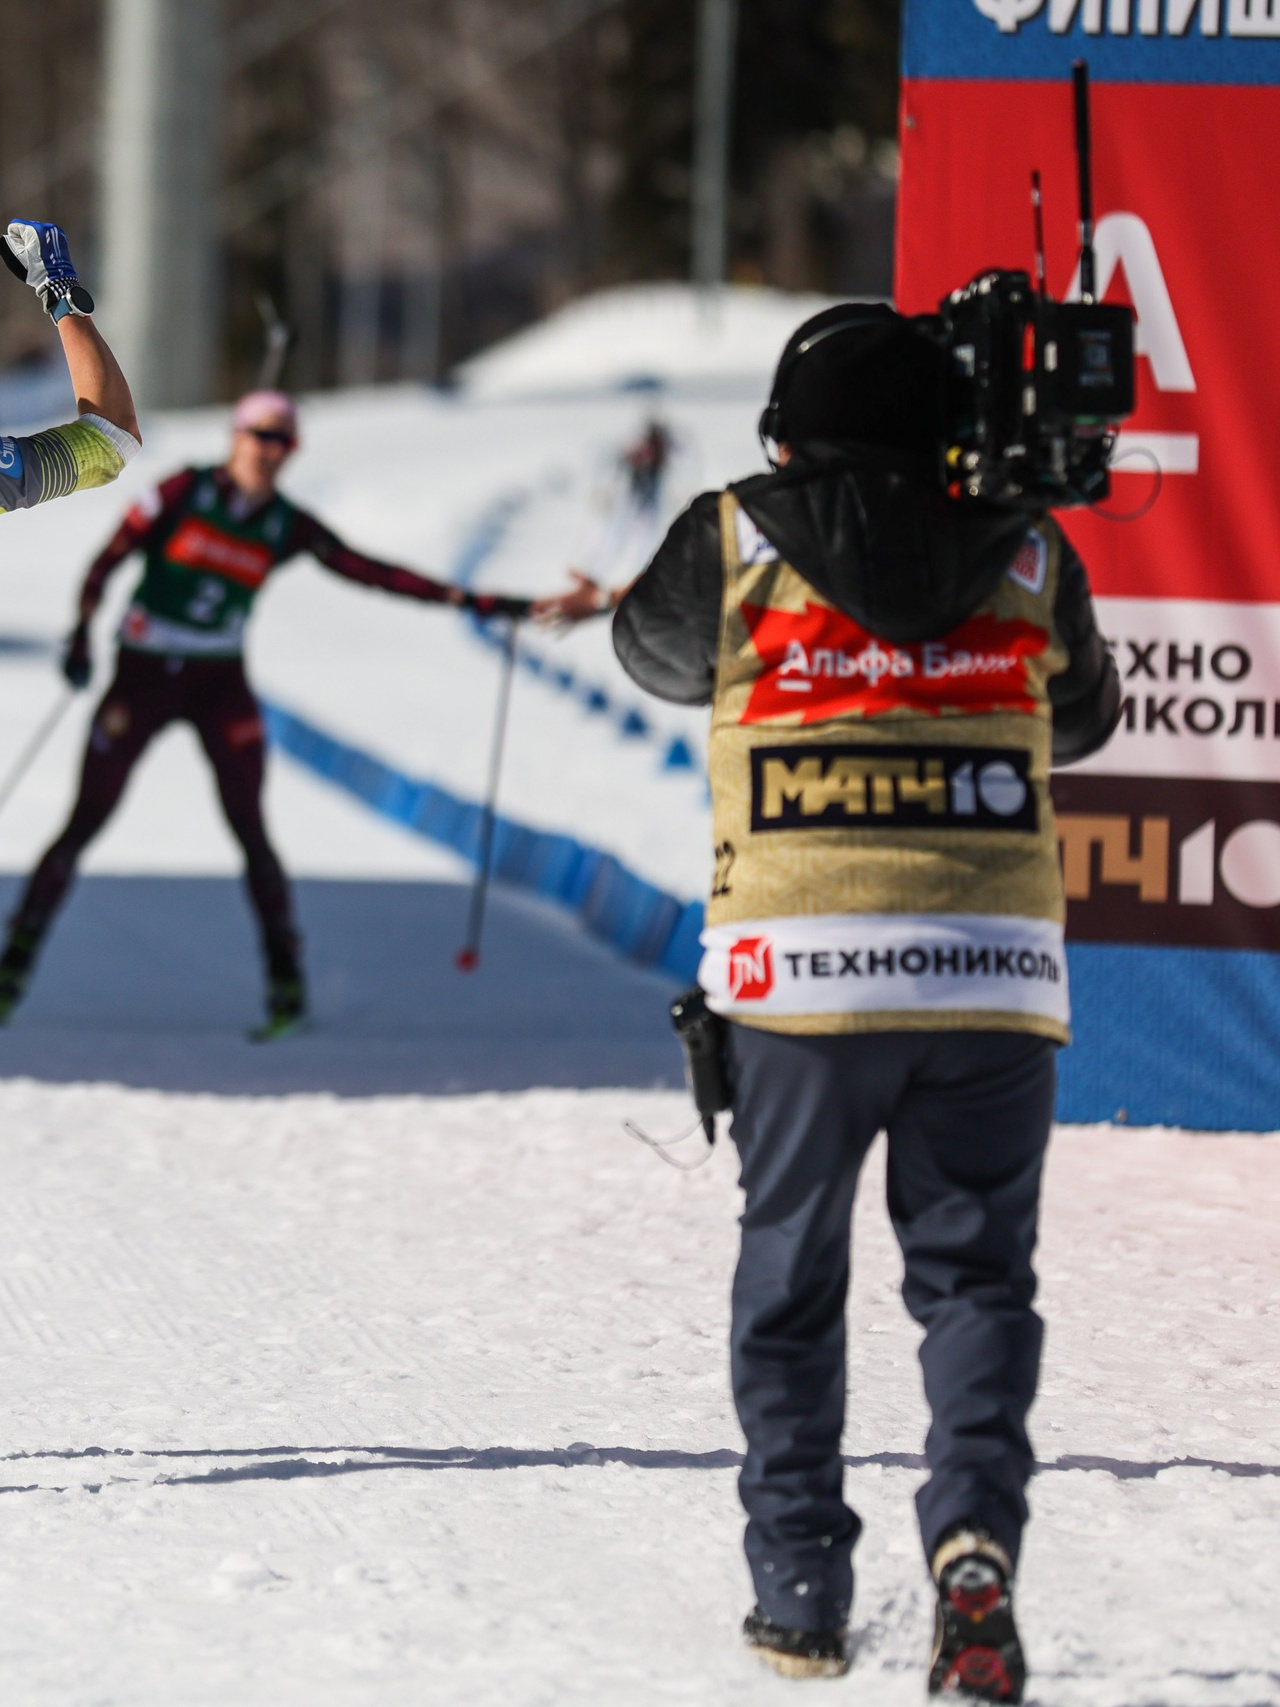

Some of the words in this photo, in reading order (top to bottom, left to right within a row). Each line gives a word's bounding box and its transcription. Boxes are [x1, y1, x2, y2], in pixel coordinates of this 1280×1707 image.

[777, 638, 915, 690] Альфа
[1106, 638, 1251, 682] ХНО
[1118, 695, 1280, 738] ИКОЛ
[784, 946, 1061, 983] ТЕХНОНИКОЛЬ
